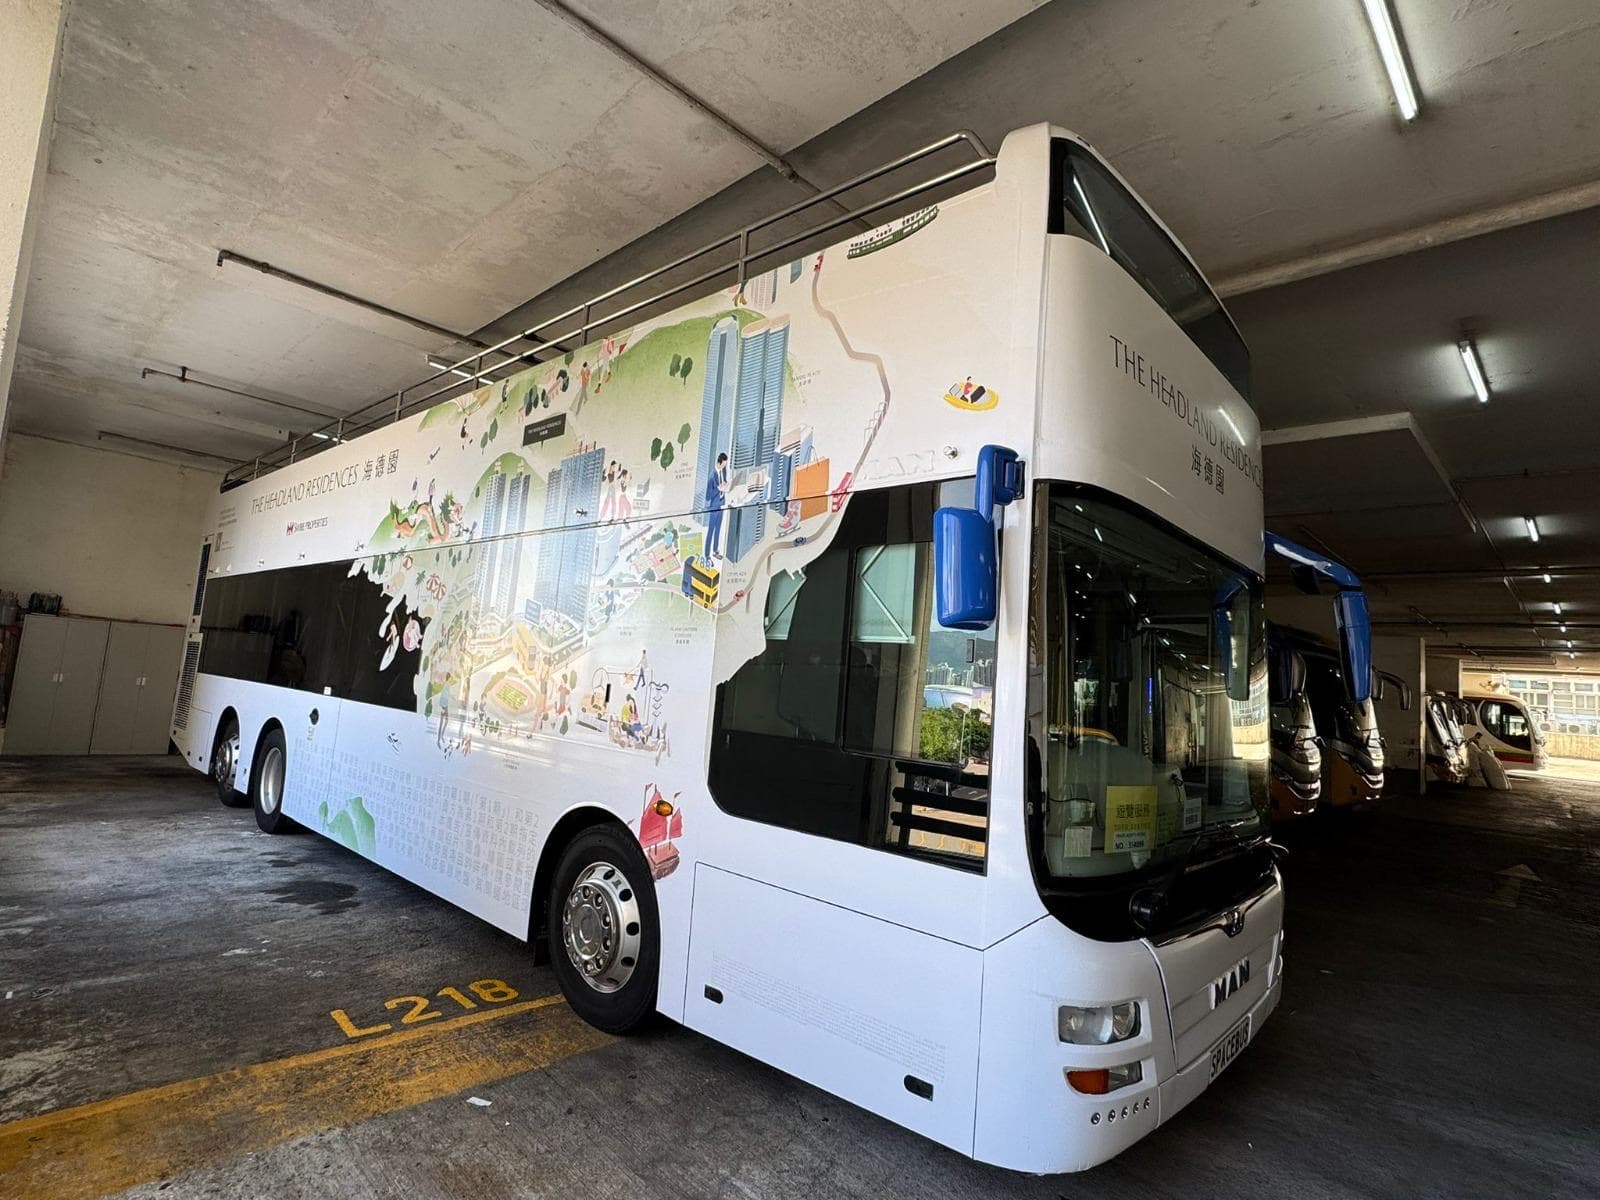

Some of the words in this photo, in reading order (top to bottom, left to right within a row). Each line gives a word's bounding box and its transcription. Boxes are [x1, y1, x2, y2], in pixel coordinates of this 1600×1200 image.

[1109, 334, 1146, 387] THE
[1150, 366, 1217, 447] HEADLAND
[251, 496, 265, 516] THE
[264, 483, 306, 512] HEADLAND
[306, 463, 359, 498] RESIDENCES
[362, 448, 400, 482] 海德園
[1191, 444, 1225, 495] 海德園
[330, 978, 519, 1038] L218
[1209, 957, 1250, 1009] MAN
[1210, 1020, 1249, 1078] SPACEBUS
